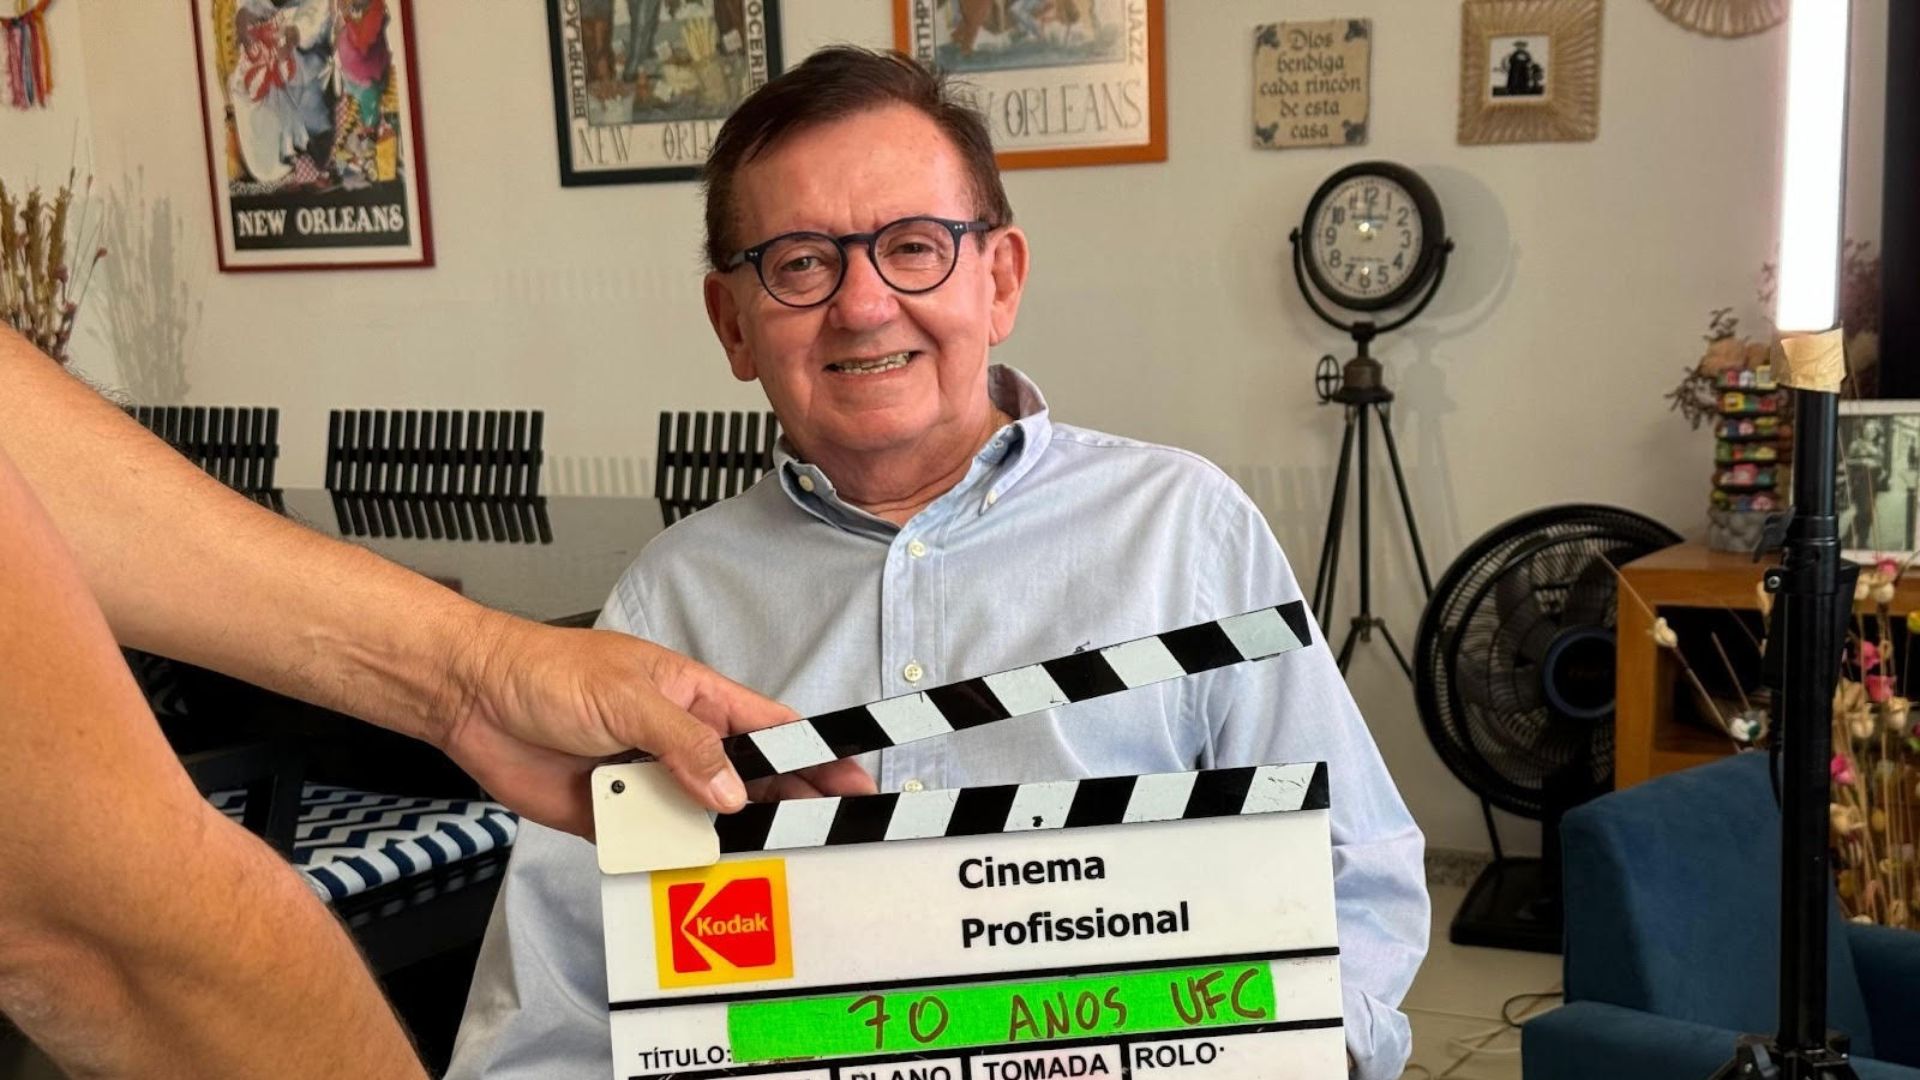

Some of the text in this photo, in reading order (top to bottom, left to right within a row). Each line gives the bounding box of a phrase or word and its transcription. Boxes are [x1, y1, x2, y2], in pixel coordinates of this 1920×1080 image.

[1277, 50, 1344, 76] bendiga
[1260, 77, 1299, 95] cada
[1004, 80, 1142, 136] ORLEANS
[1280, 98, 1340, 118] de esta
[1290, 122, 1329, 139] casa
[577, 124, 633, 164] NEW
[1364, 186, 1379, 203] 12
[238, 204, 404, 237] NEW ORLEANS
[1333, 206, 1345, 225] 10
[1397, 207, 1409, 226] 2
[1326, 227, 1337, 246] 9
[1401, 230, 1411, 248] 3
[1329, 249, 1342, 268] 8
[1393, 253, 1403, 270] 4
[1345, 264, 1355, 282] 7
[1378, 265, 1389, 284] 5
[958, 856, 1106, 889] Cinema
[696, 913, 769, 937] Kodak
[961, 901, 1190, 948] Profissional
[1008, 986, 1127, 1041] ANOS
[1170, 968, 1267, 1025] UFC
[638, 1045, 733, 1070] TÍTULO:
[983, 1053, 1110, 1080] TOMADA
